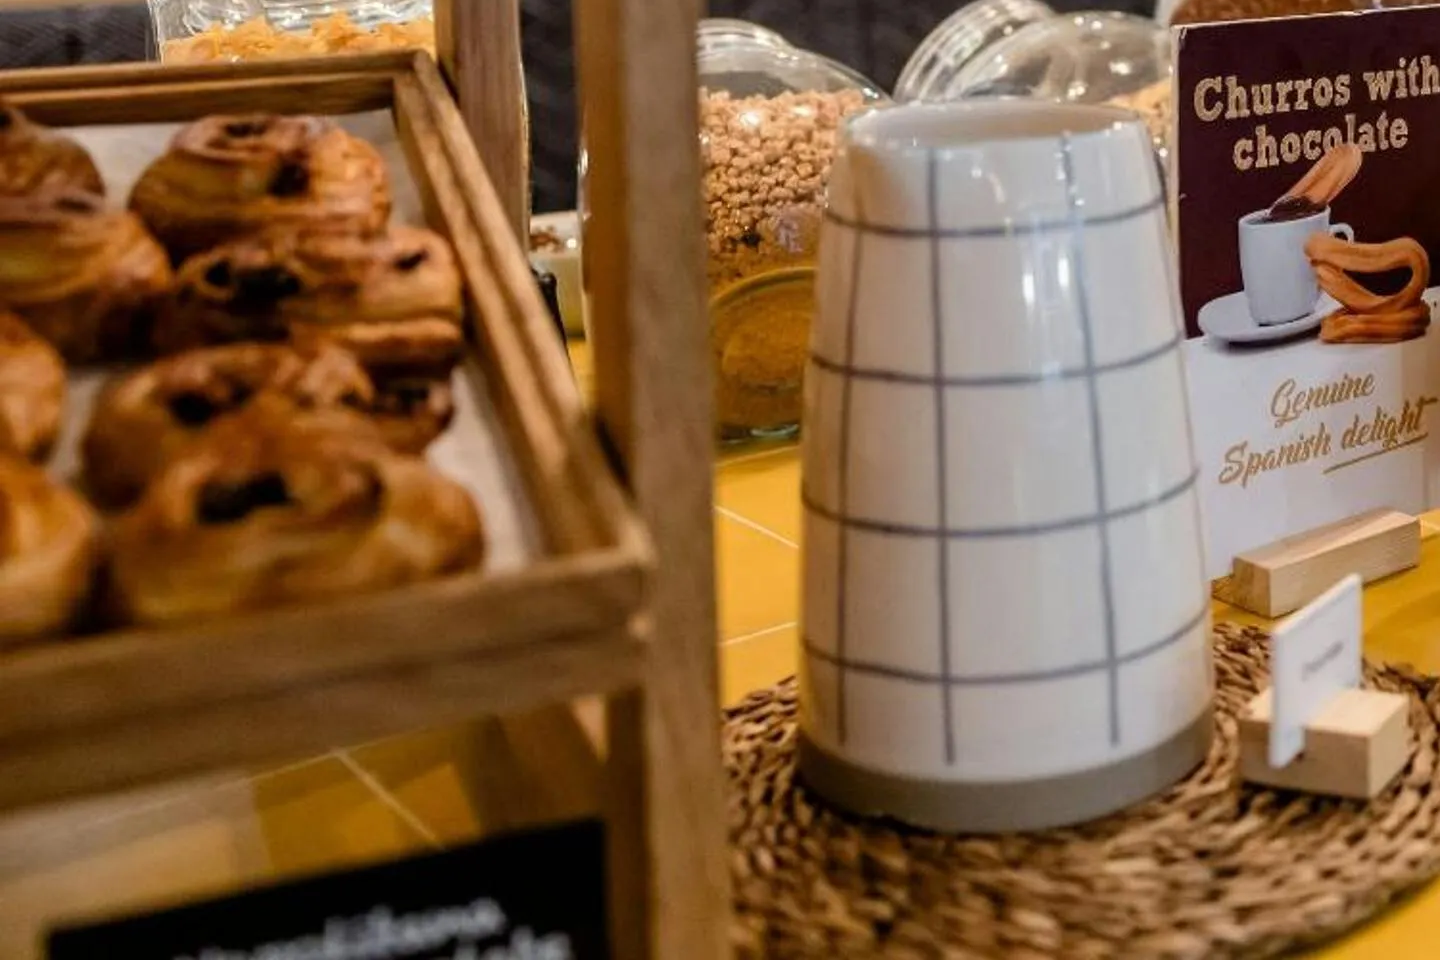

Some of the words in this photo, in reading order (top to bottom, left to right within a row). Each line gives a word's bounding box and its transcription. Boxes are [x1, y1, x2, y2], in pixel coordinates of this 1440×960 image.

[1193, 73, 1351, 122] Churros
[1232, 111, 1409, 171] chocolate
[1271, 373, 1376, 429] Genuine
[1219, 422, 1332, 489] Spanish
[1341, 396, 1439, 450] delight
